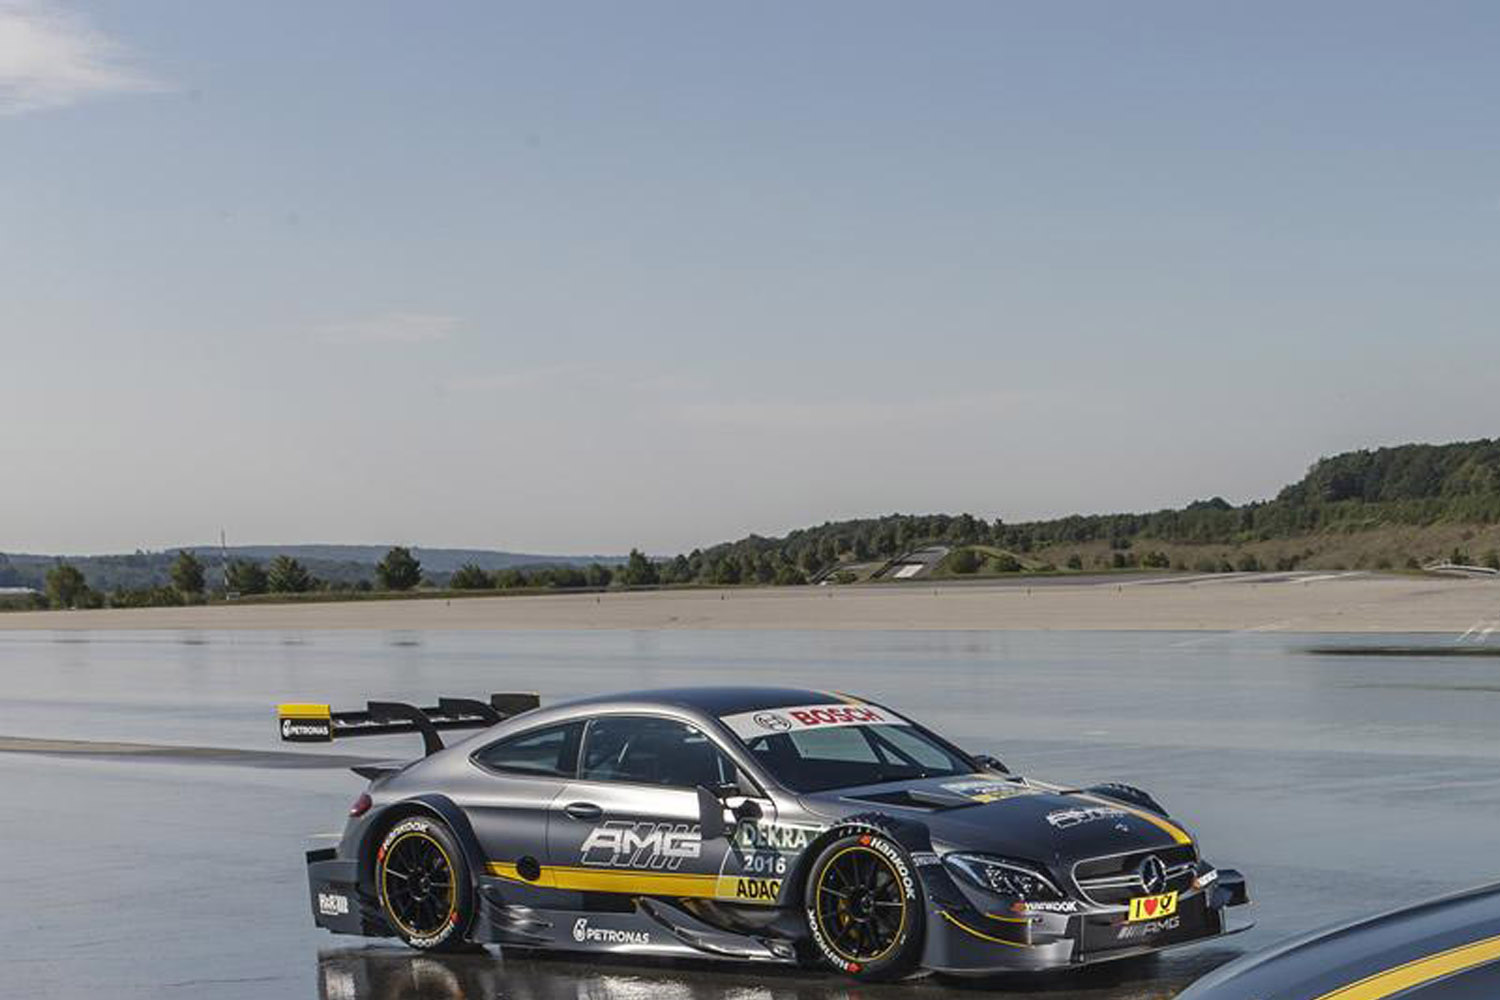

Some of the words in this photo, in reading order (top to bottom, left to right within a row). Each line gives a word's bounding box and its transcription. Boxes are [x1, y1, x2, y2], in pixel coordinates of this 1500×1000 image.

[789, 707, 885, 726] BOSCH
[581, 828, 702, 858] AMG
[742, 823, 808, 849] DEKRA
[744, 855, 786, 874] 2016
[586, 928, 650, 944] PETRONAS
